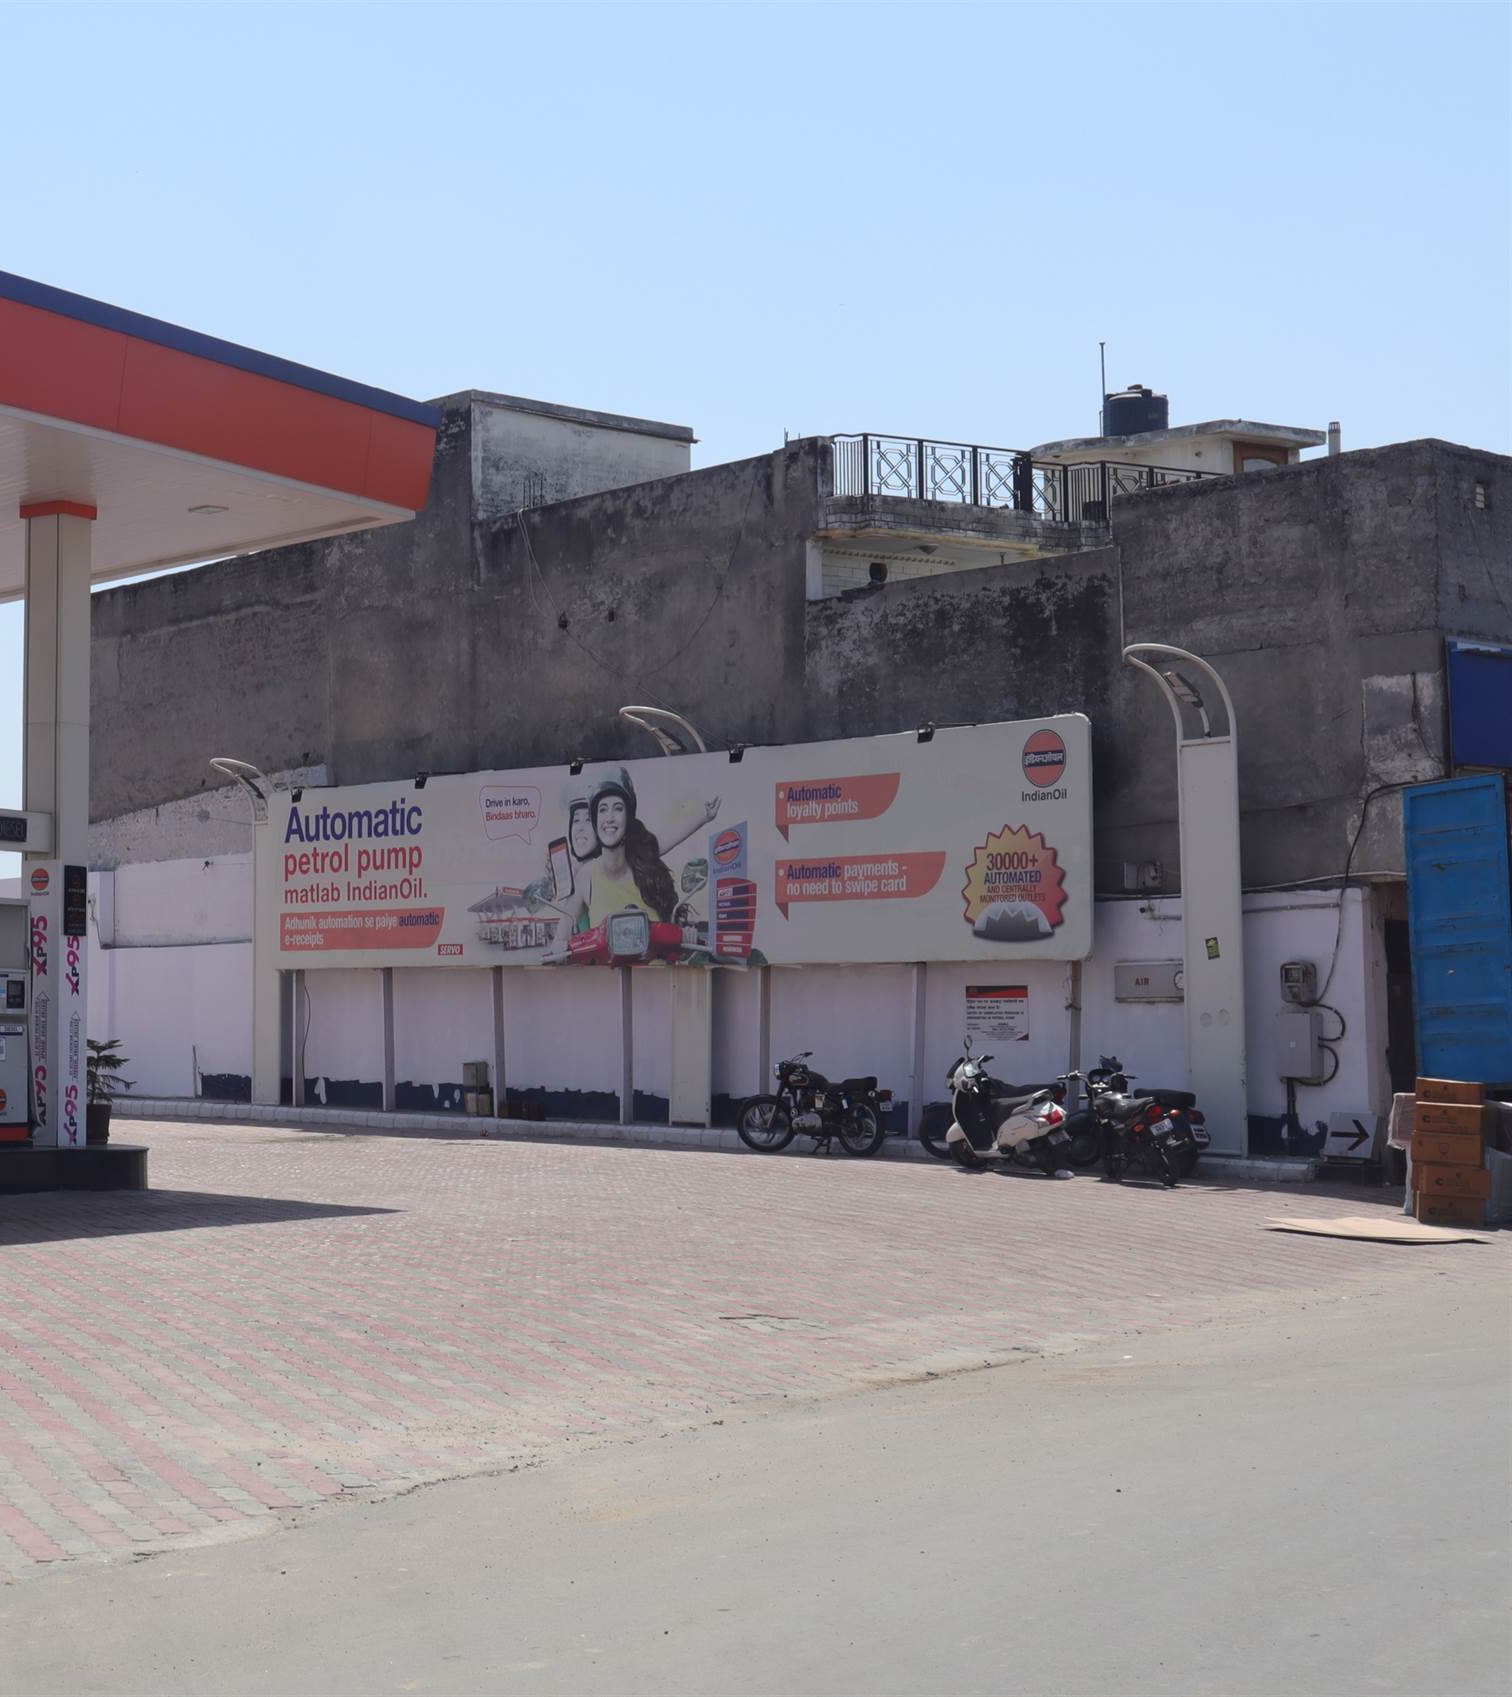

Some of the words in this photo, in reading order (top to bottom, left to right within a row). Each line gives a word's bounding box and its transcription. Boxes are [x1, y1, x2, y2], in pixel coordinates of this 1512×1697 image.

[788, 783, 842, 802] Automatic
[1021, 788, 1068, 802] IndianOil
[485, 798, 503, 808] Drive
[504, 798, 511, 807] in
[787, 800, 823, 820] loyalty
[824, 799, 858, 818] points
[284, 797, 423, 844] Automatic
[486, 811, 514, 822] Bindaas
[284, 843, 349, 882] petrol
[357, 845, 423, 879] pump
[787, 862, 842, 881] Automatic
[844, 861, 899, 880] payments
[986, 851, 1039, 871] 30000+
[787, 882, 800, 896] no
[802, 880, 829, 896] need
[832, 879, 842, 894] to
[845, 878, 879, 895] swipe
[880, 876, 907, 892] card
[984, 870, 1042, 885] AUTOMATED
[284, 882, 341, 904] matlab
[347, 877, 428, 902] IndianOil.
[284, 915, 317, 930] Adhunik
[318, 913, 363, 929] automation
[364, 917, 375, 928] se
[375, 914, 398, 930] paiye
[399, 912, 440, 927] automatic
[31, 915, 48, 976] XP95
[284, 931, 324, 947] e-receipts
[66, 935, 80, 996] XP95
[1134, 977, 1150, 986] AIR
[64, 1084, 78, 1145] XP95
